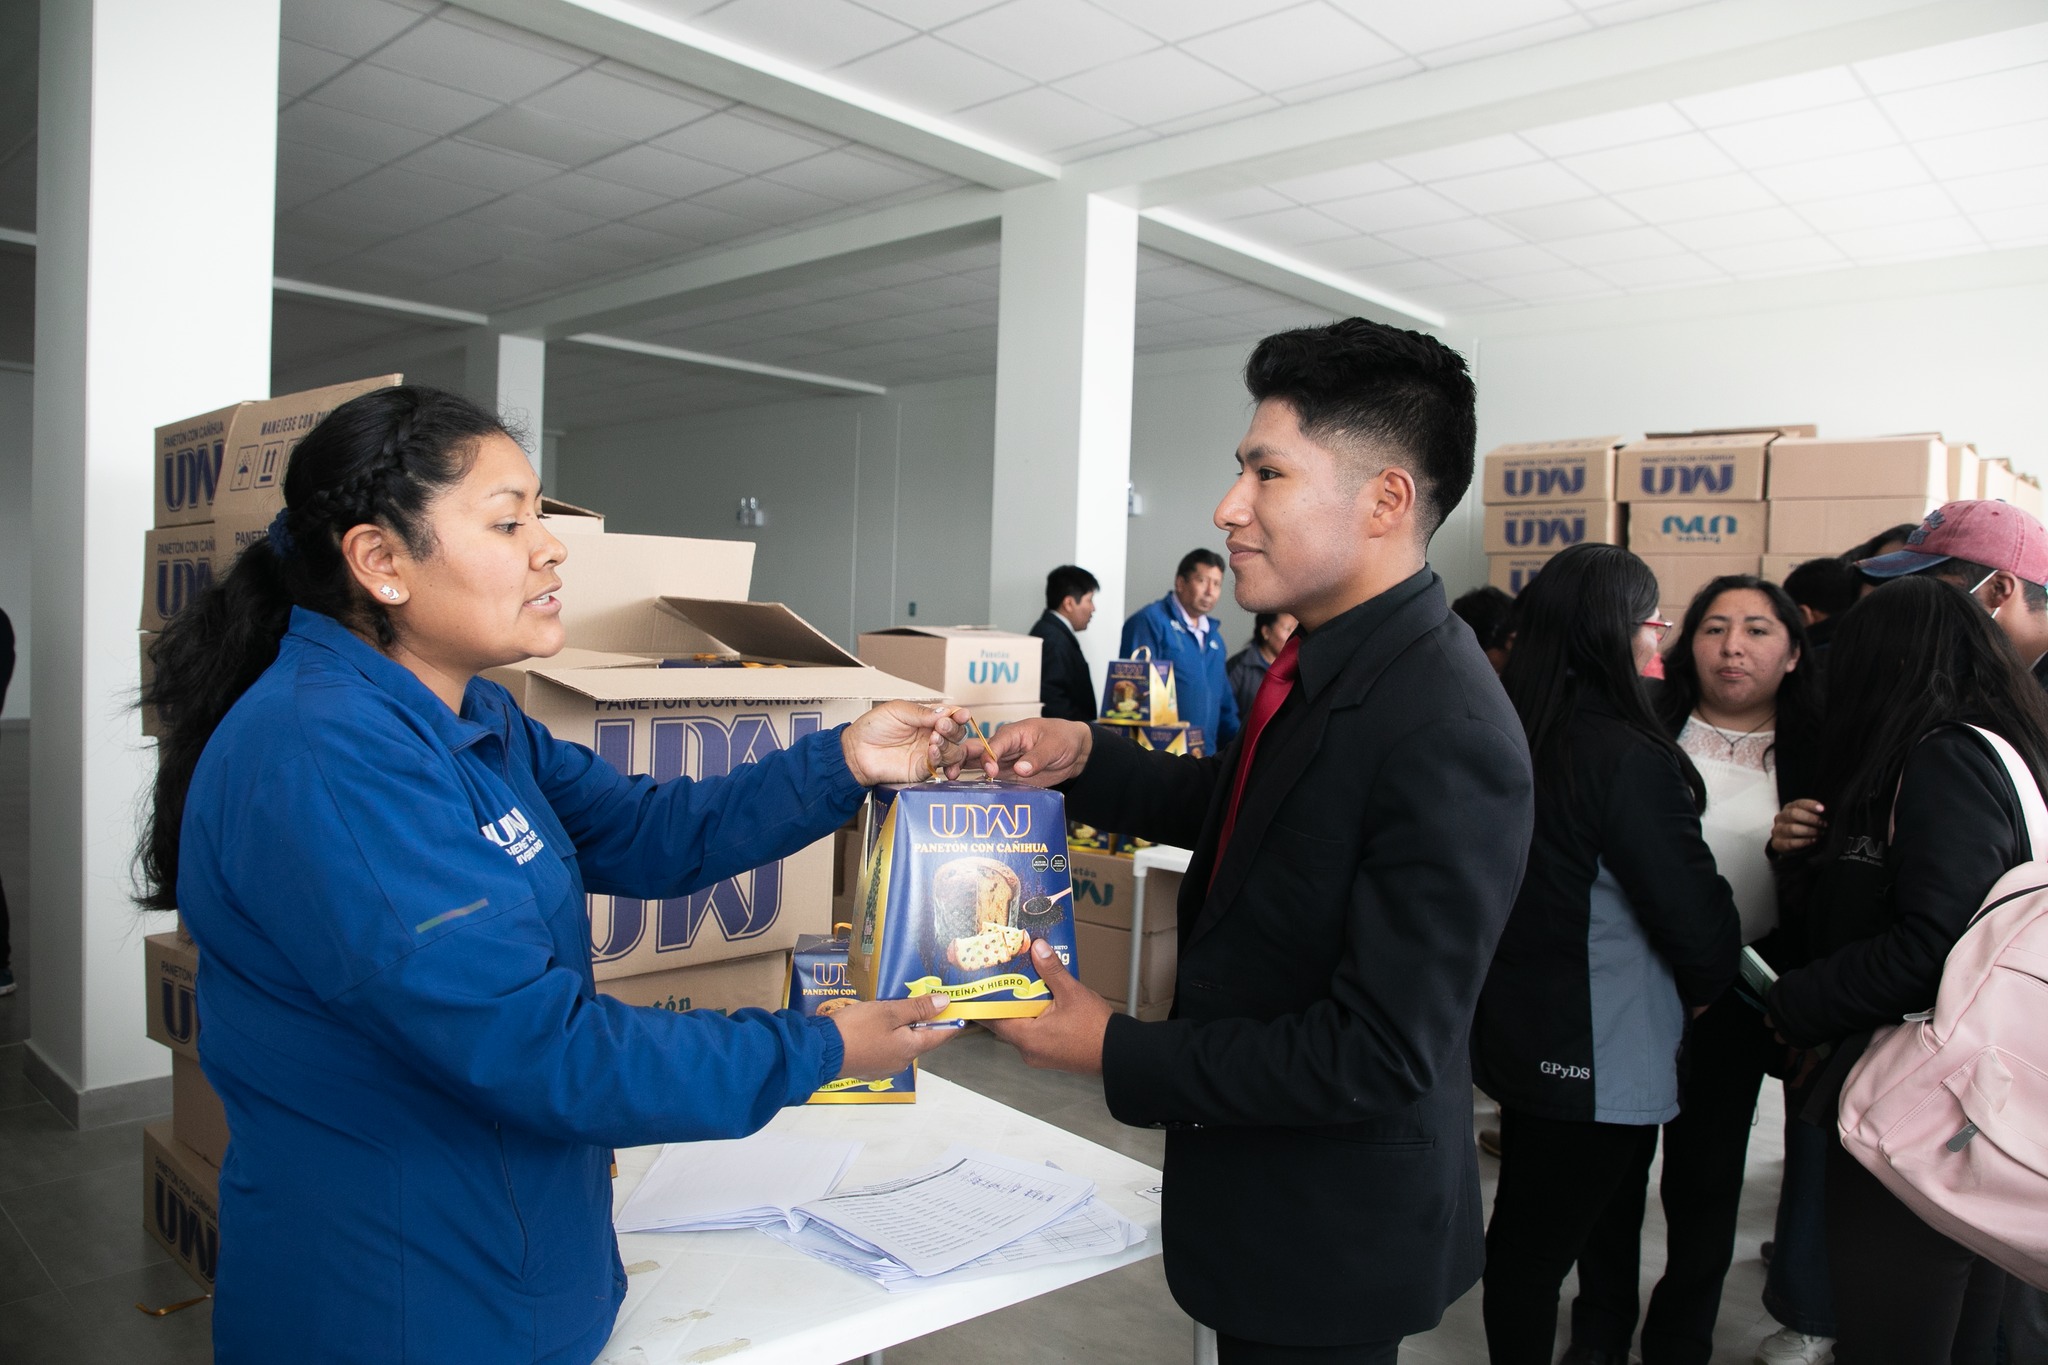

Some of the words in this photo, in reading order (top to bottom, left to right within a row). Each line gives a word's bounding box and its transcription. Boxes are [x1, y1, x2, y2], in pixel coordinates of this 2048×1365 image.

[914, 841, 968, 853] PANETÓN
[971, 843, 995, 853] CON
[996, 840, 1048, 853] CAÑIHUA
[988, 979, 1023, 989] HIERRO
[803, 986, 839, 996] PANETÓN
[840, 988, 857, 996] CON
[1540, 1061, 1591, 1080] GPyDS
